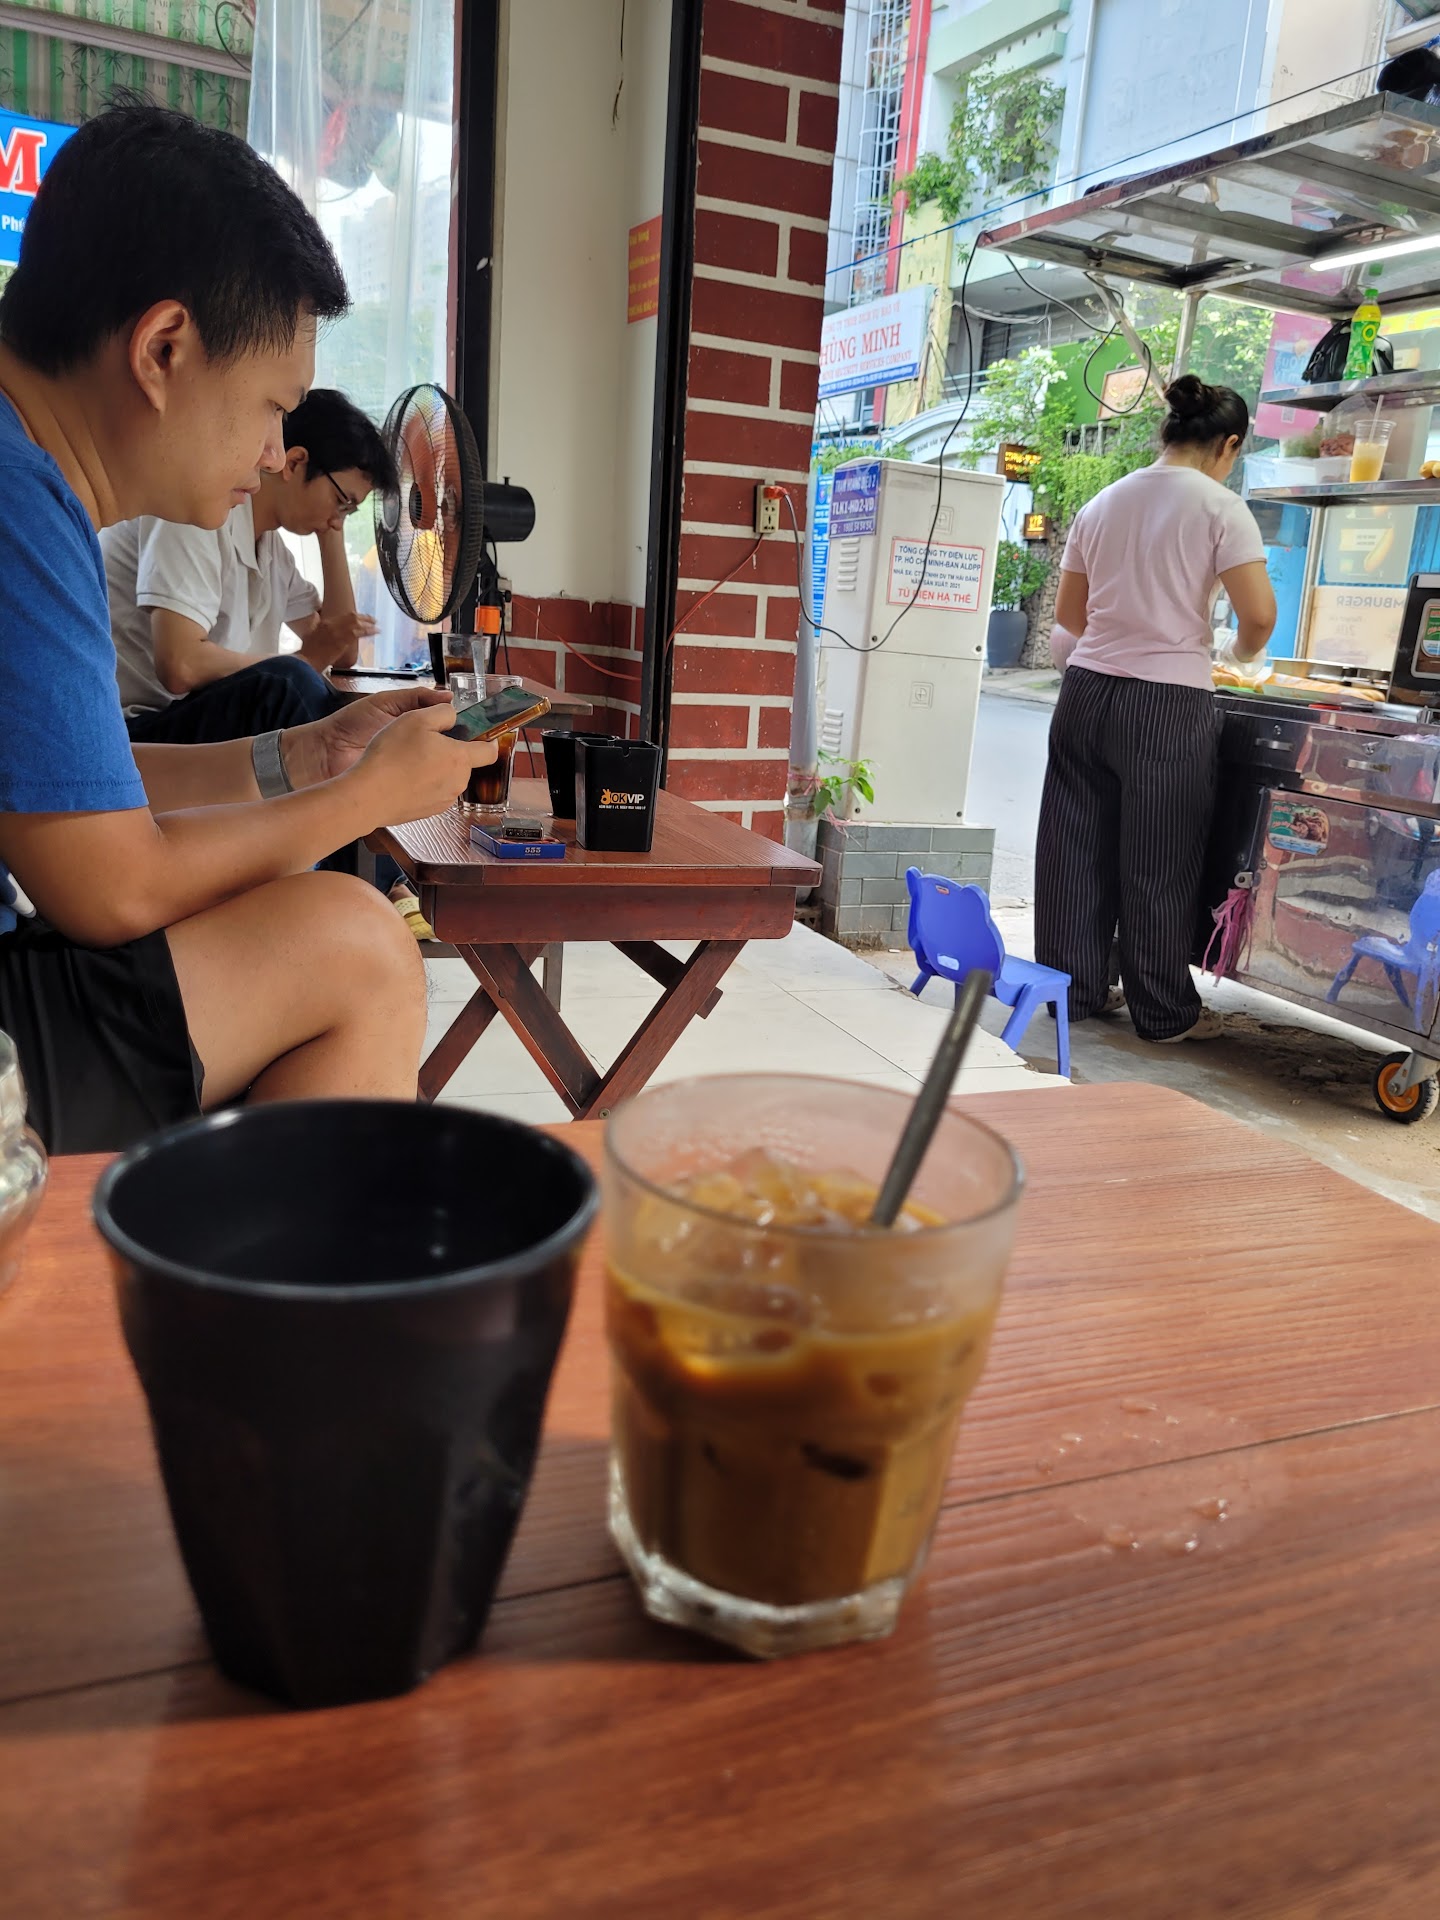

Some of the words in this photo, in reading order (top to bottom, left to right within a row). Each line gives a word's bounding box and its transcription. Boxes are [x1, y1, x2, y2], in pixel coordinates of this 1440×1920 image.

[0, 127, 47, 197] M
[861, 322, 902, 356] MINH
[886, 349, 913, 367] COMPANY
[894, 555, 903, 563] TP.
[904, 556, 915, 565] HỒ
[915, 557, 926, 565] CH
[939, 550, 948, 558] TY
[964, 553, 978, 561] LỰC
[937, 592, 950, 604] HẠ
[953, 592, 971, 604] THẾ
